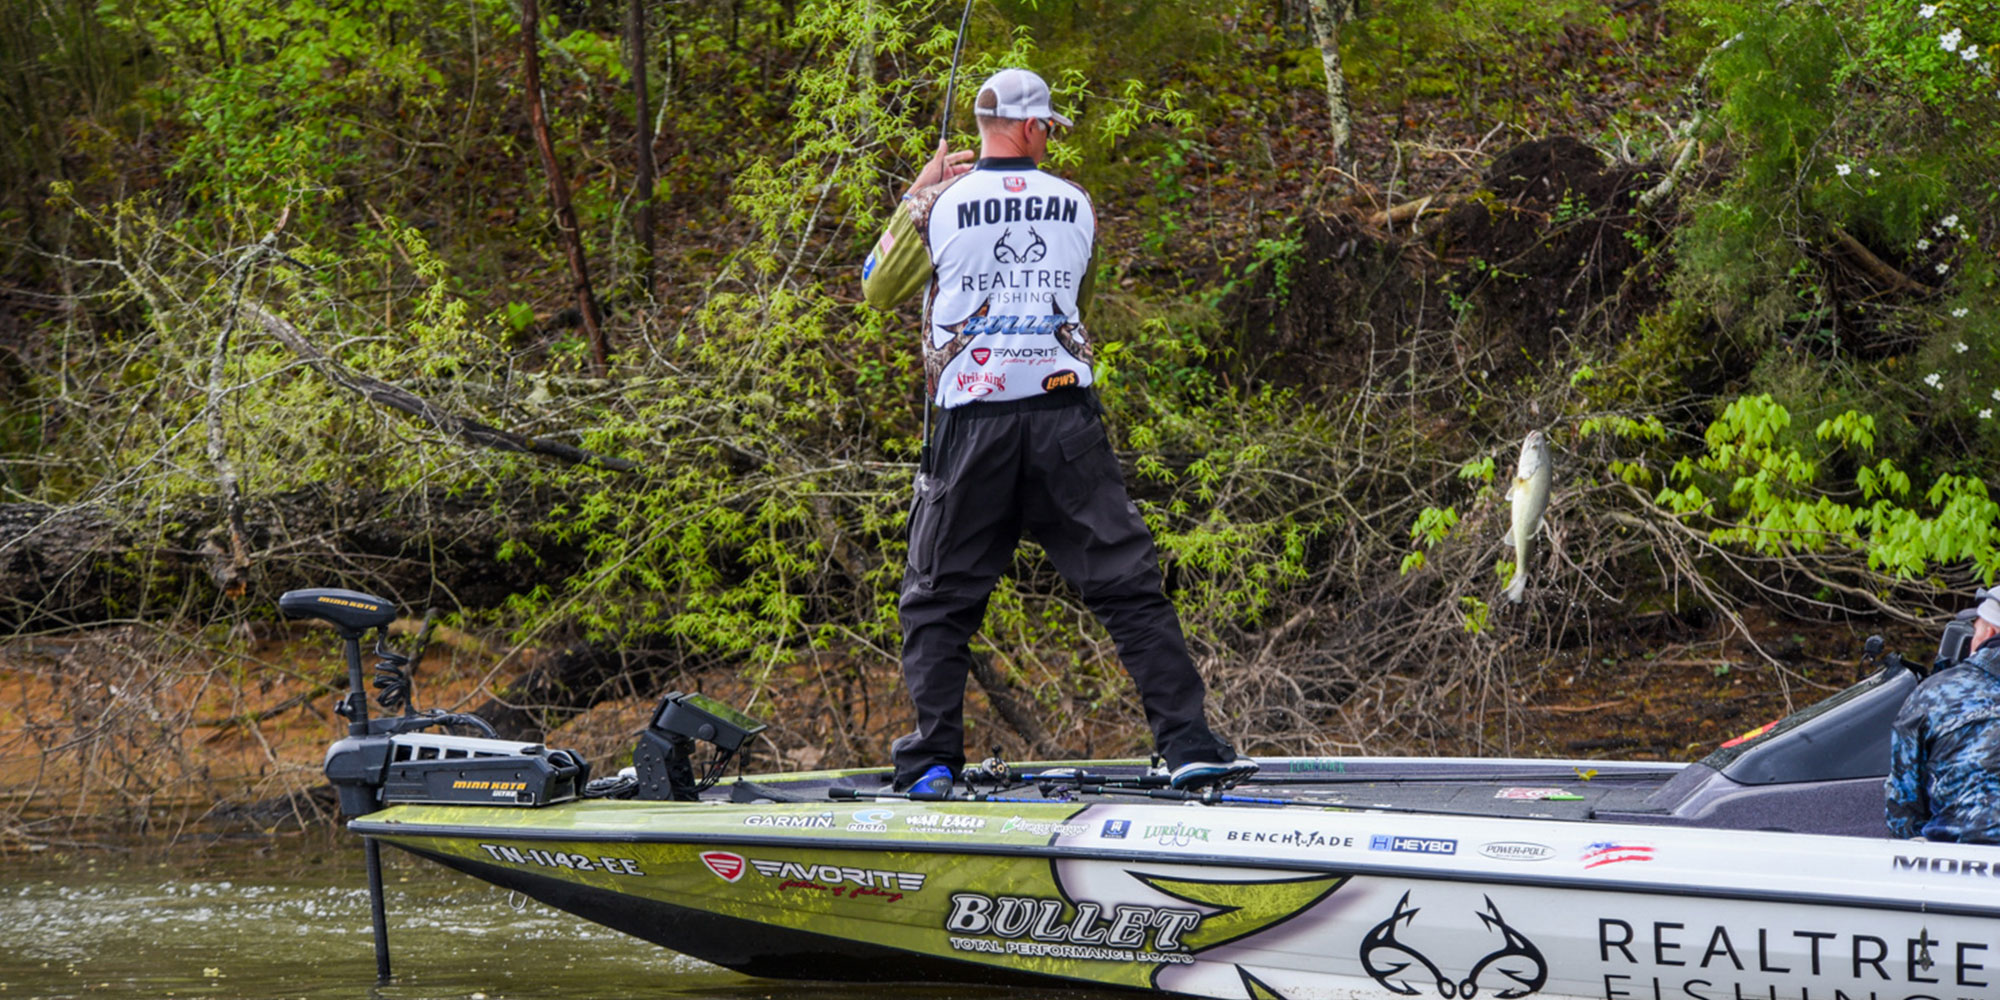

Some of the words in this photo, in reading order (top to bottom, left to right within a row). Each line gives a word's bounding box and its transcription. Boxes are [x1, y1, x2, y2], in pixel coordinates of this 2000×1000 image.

[957, 196, 1078, 229] MORGAN
[962, 270, 1071, 292] REALTREE
[988, 292, 1053, 304] FISHING
[490, 782, 527, 790] KOTA
[743, 813, 834, 828] GARMIN
[847, 823, 887, 832] COSTA
[941, 815, 986, 828] EAGLE
[1394, 838, 1455, 853] HEYBO
[1486, 845, 1547, 856] POWER-POLE
[479, 844, 646, 876] TN-1142-EE
[749, 859, 927, 891] FAVORITE
[947, 893, 1200, 950] BULLET
[950, 937, 1004, 953] TOTAL
[1006, 941, 1134, 961] PERFORMANCE
[1136, 951, 1194, 964] BOATS
[1600, 918, 1988, 988] REALTREE
